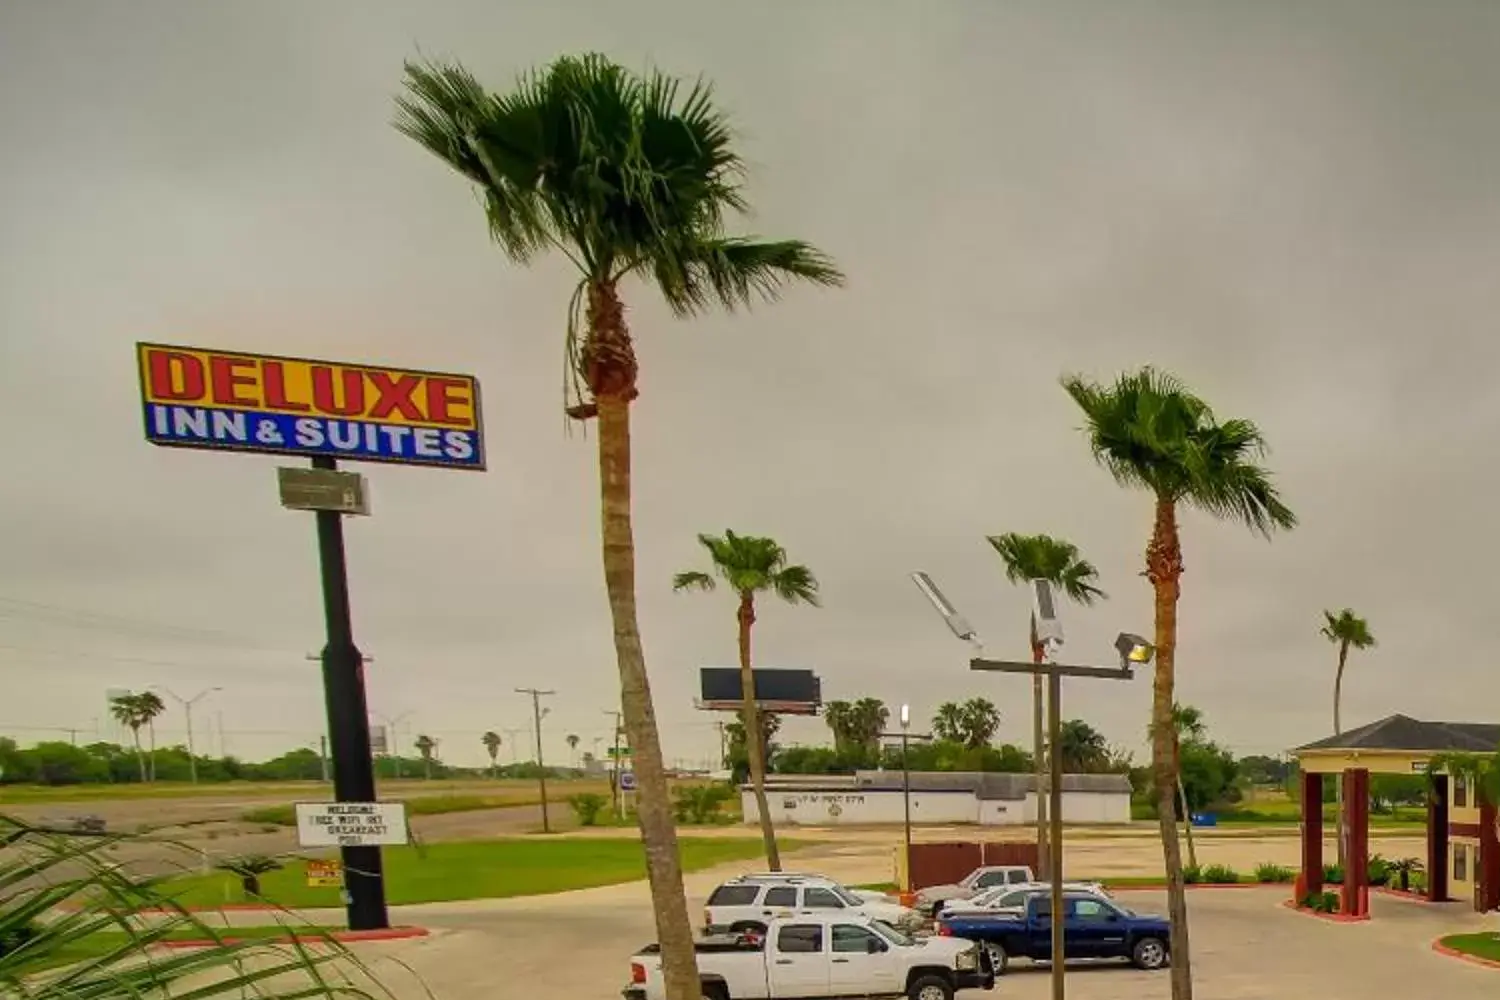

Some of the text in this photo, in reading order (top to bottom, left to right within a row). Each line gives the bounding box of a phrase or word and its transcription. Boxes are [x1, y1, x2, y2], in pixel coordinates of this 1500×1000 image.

[148, 351, 471, 426] DELUXE
[153, 405, 473, 459] INN & SUITES
